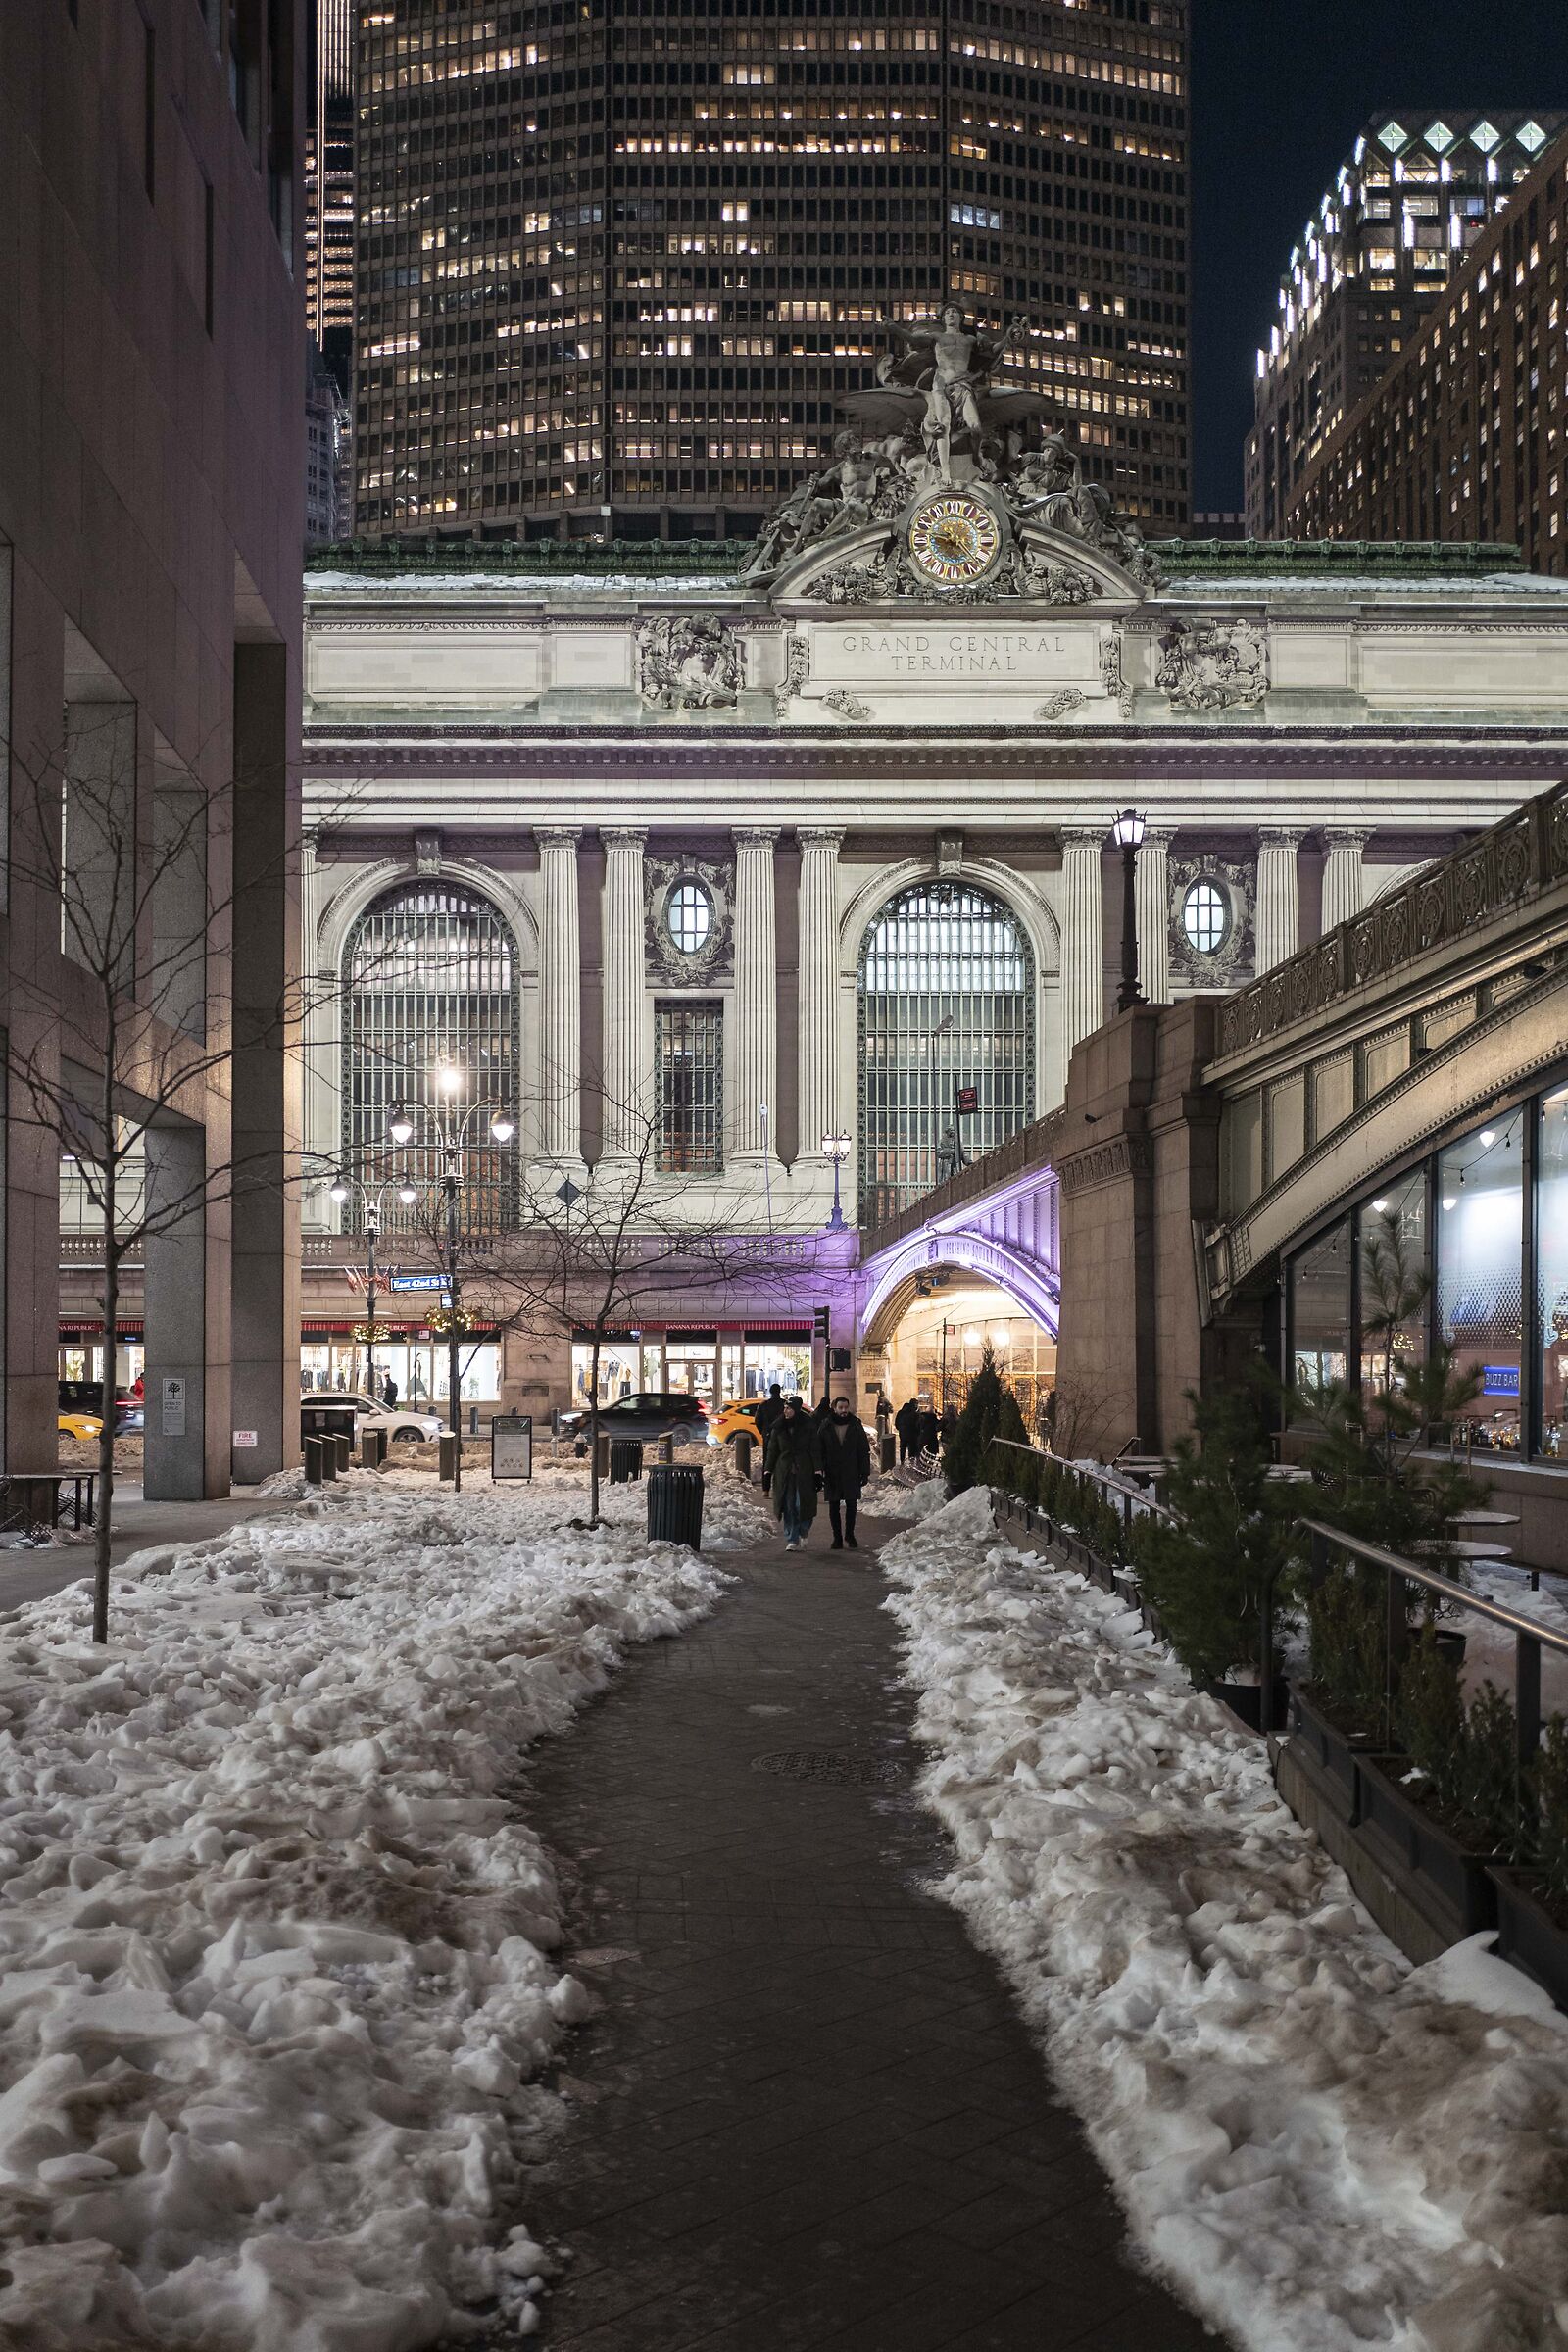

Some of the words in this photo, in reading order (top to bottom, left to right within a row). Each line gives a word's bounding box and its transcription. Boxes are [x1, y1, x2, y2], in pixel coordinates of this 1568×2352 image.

[932, 505, 943, 518] XI
[976, 519, 989, 527] II
[843, 636, 930, 652] GRAND
[949, 636, 1065, 652] CENTRAL
[891, 655, 1017, 671] TERMINAL
[411, 1279, 430, 1287] 42nd
[1485, 1373, 1502, 1385] BUZZ
[1504, 1374, 1518, 1387] BAR
